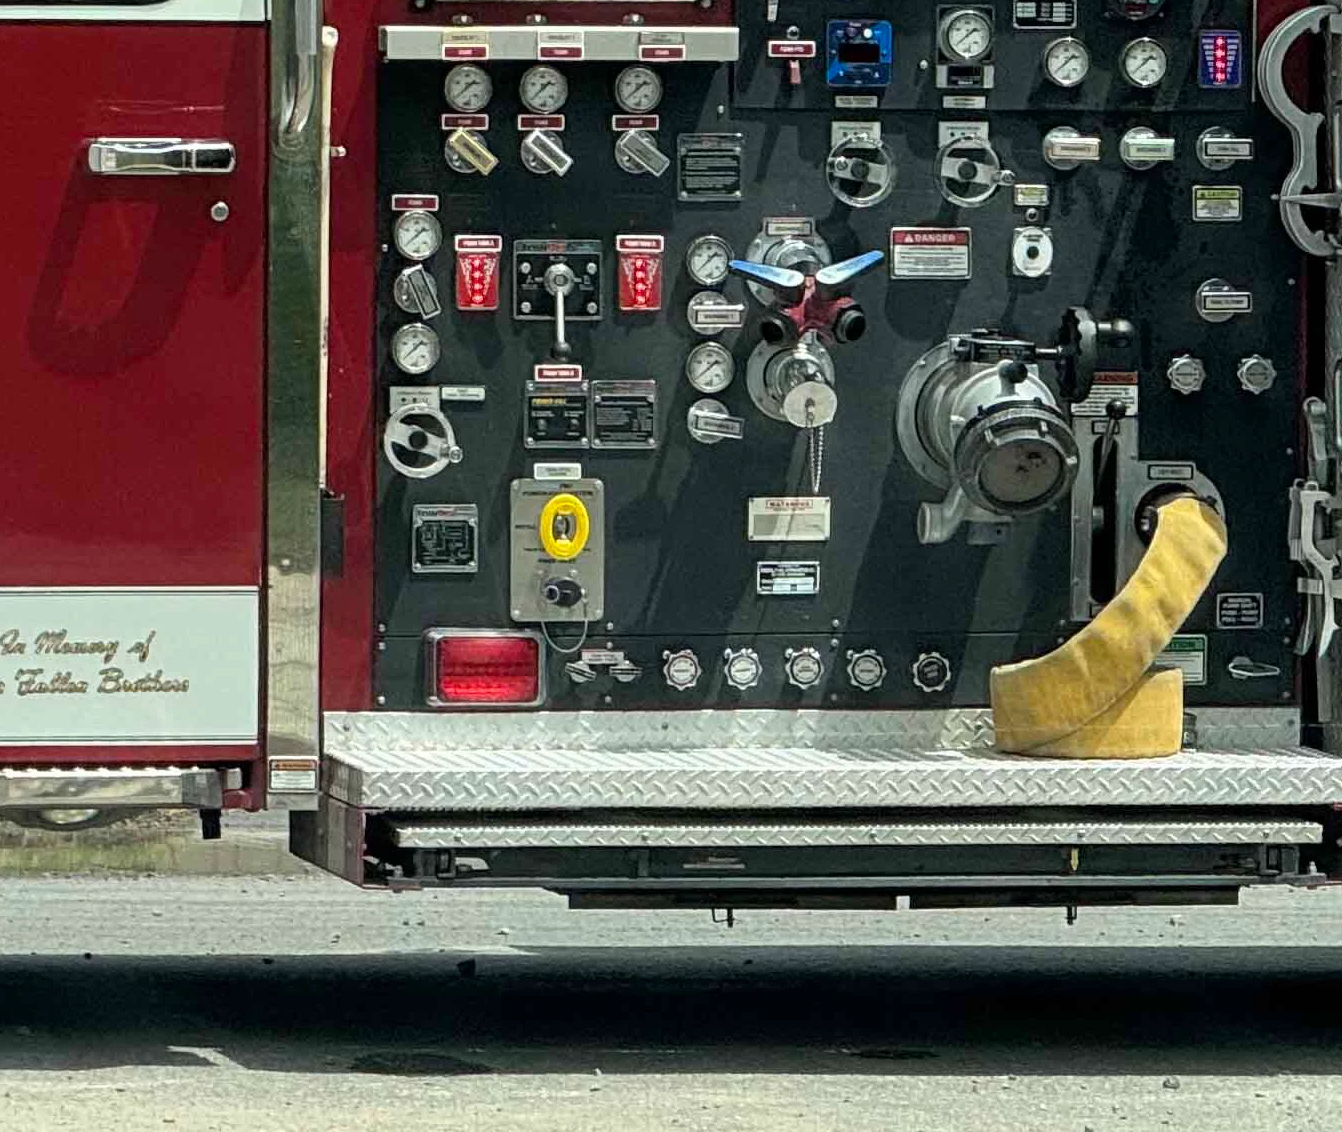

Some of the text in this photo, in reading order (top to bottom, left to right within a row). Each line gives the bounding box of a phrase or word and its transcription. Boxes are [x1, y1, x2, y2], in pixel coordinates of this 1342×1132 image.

[914, 233, 957, 242] DANGER
[0, 629, 26, 656] In
[127, 630, 156, 662] of
[97, 667, 190, 694] Brothers
